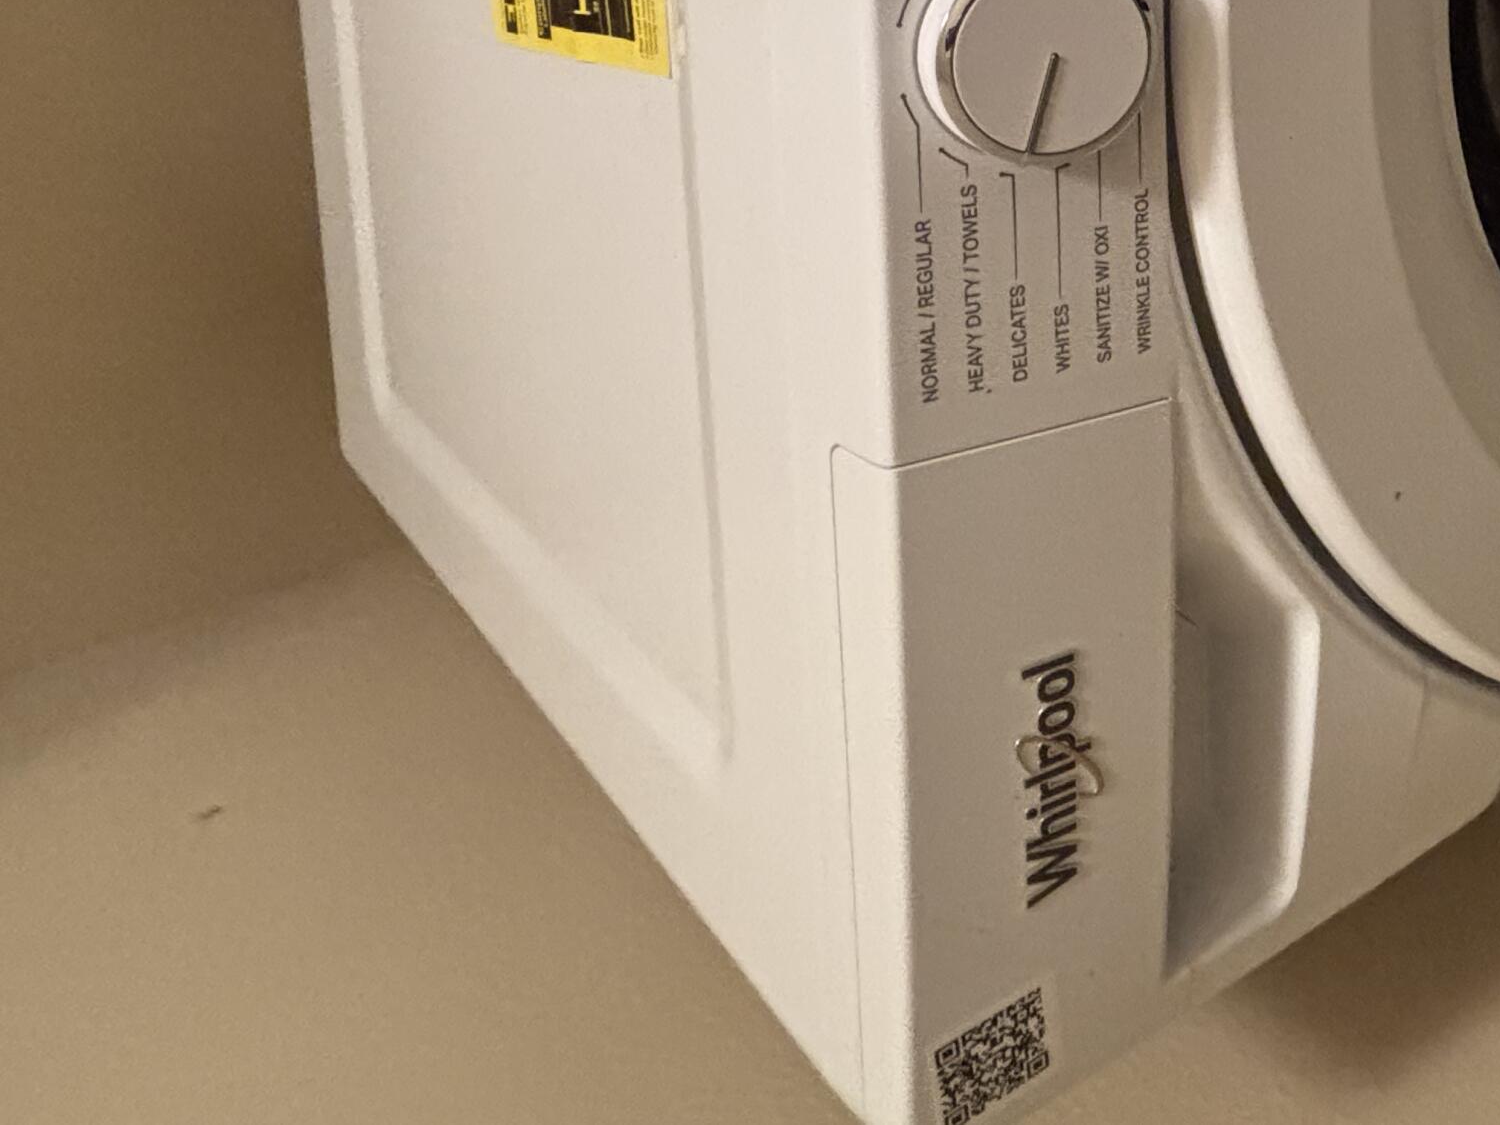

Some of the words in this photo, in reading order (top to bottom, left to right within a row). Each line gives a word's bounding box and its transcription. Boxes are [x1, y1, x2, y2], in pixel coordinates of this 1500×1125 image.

[960, 184, 980, 263] TOWELS
[1094, 225, 1109, 255] OXI
[1134, 188, 1150, 272] CONTROL
[915, 219, 934, 309] REGULAR
[1095, 261, 1109, 282] W/
[964, 279, 982, 328] DUTY
[1009, 284, 1029, 382] DELICATES
[1054, 303, 1071, 374] WHITES
[1096, 285, 1112, 363] SANITIZE
[1135, 276, 1152, 354] WRINKLE
[919, 322, 939, 404] NORMAL
[965, 333, 985, 393] HEAVY
[1021, 652, 1092, 909] Whirlpool
